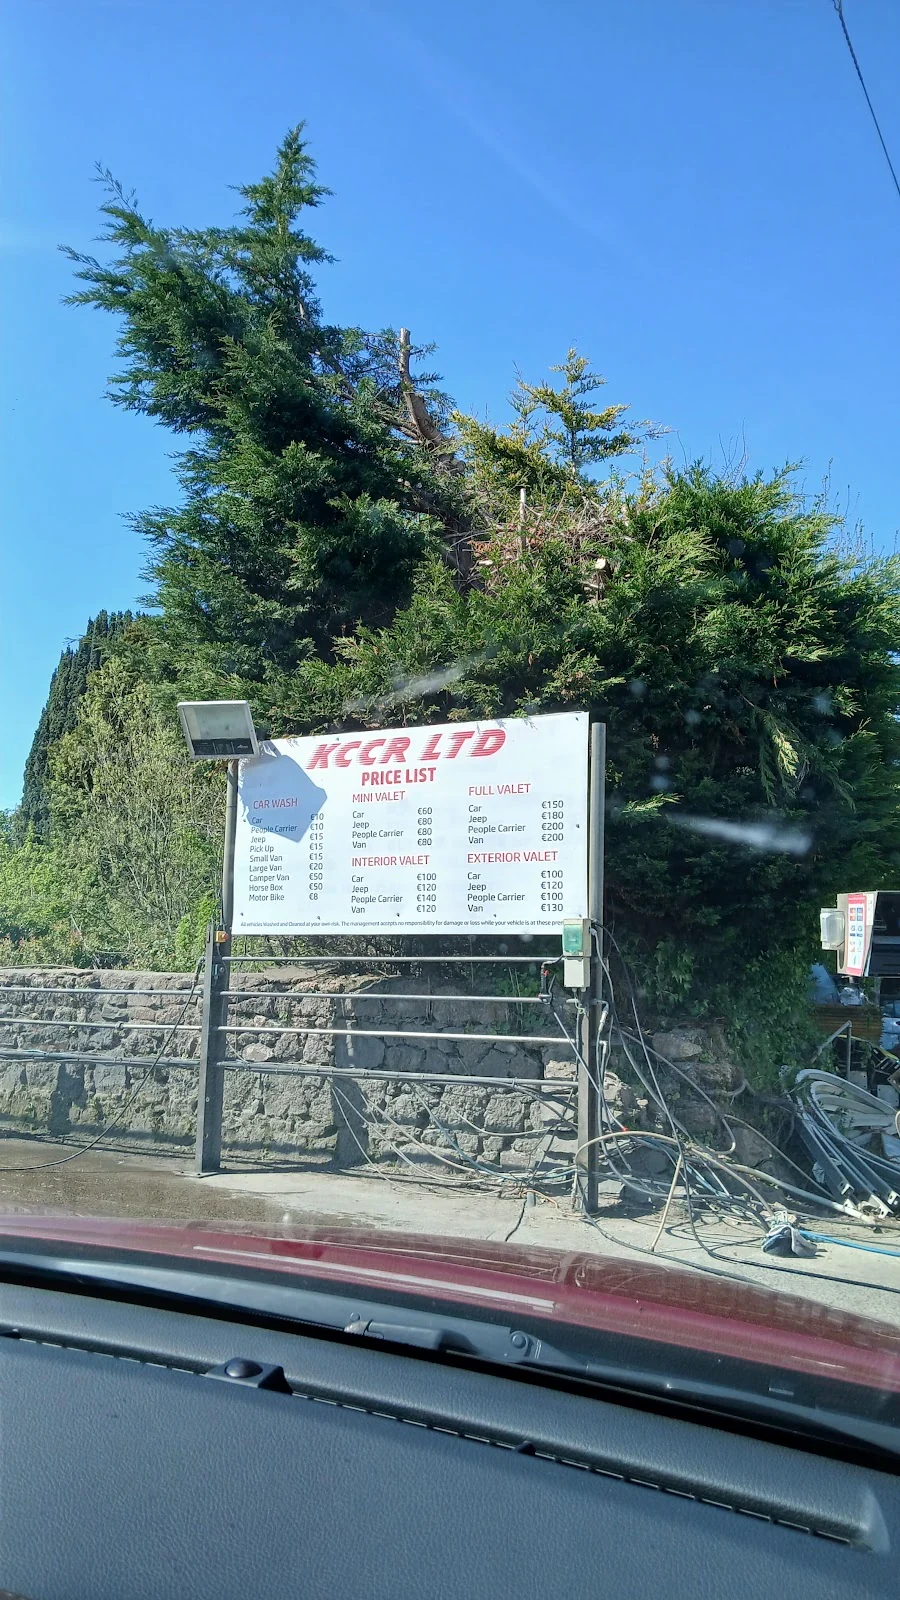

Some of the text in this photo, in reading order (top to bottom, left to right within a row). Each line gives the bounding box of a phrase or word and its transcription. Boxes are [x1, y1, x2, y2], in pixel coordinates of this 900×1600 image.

[305, 728, 506, 770] KCCR LTD
[362, 767, 436, 786] PRICE LIST
[468, 784, 531, 796] FULL VALET
[352, 791, 406, 803] MINI VALET
[253, 798, 298, 809] CAR WASH
[542, 800, 564, 808] €150
[418, 807, 432, 815] €60
[468, 811, 564, 824] Jeep €180
[251, 826, 274, 834] People
[310, 822, 324, 830] €10
[352, 821, 370, 830] Jeep
[468, 822, 564, 834] People Carrier €200
[352, 830, 378, 840] People
[378, 830, 404, 838] Carrier
[542, 833, 564, 842] €200
[418, 838, 432, 846] €80
[264, 845, 274, 853] Up
[250, 854, 268, 862] Small
[352, 855, 430, 866] INTERIOR VALET
[468, 851, 558, 863] EXTERIOR VALET
[249, 865, 268, 873] Large
[309, 862, 324, 870] €20
[249, 874, 275, 882] Camper
[309, 872, 324, 880] €50
[468, 870, 564, 880] Car €100
[309, 882, 323, 890] €50
[352, 884, 436, 894] Jeep €120
[468, 881, 564, 892] Jeep €120
[309, 892, 318, 900] €8
[351, 895, 376, 904] People
[416, 894, 436, 902] €140
[468, 892, 564, 902] People Carrier €100
[416, 904, 436, 912] €120
[540, 904, 564, 912] €130
